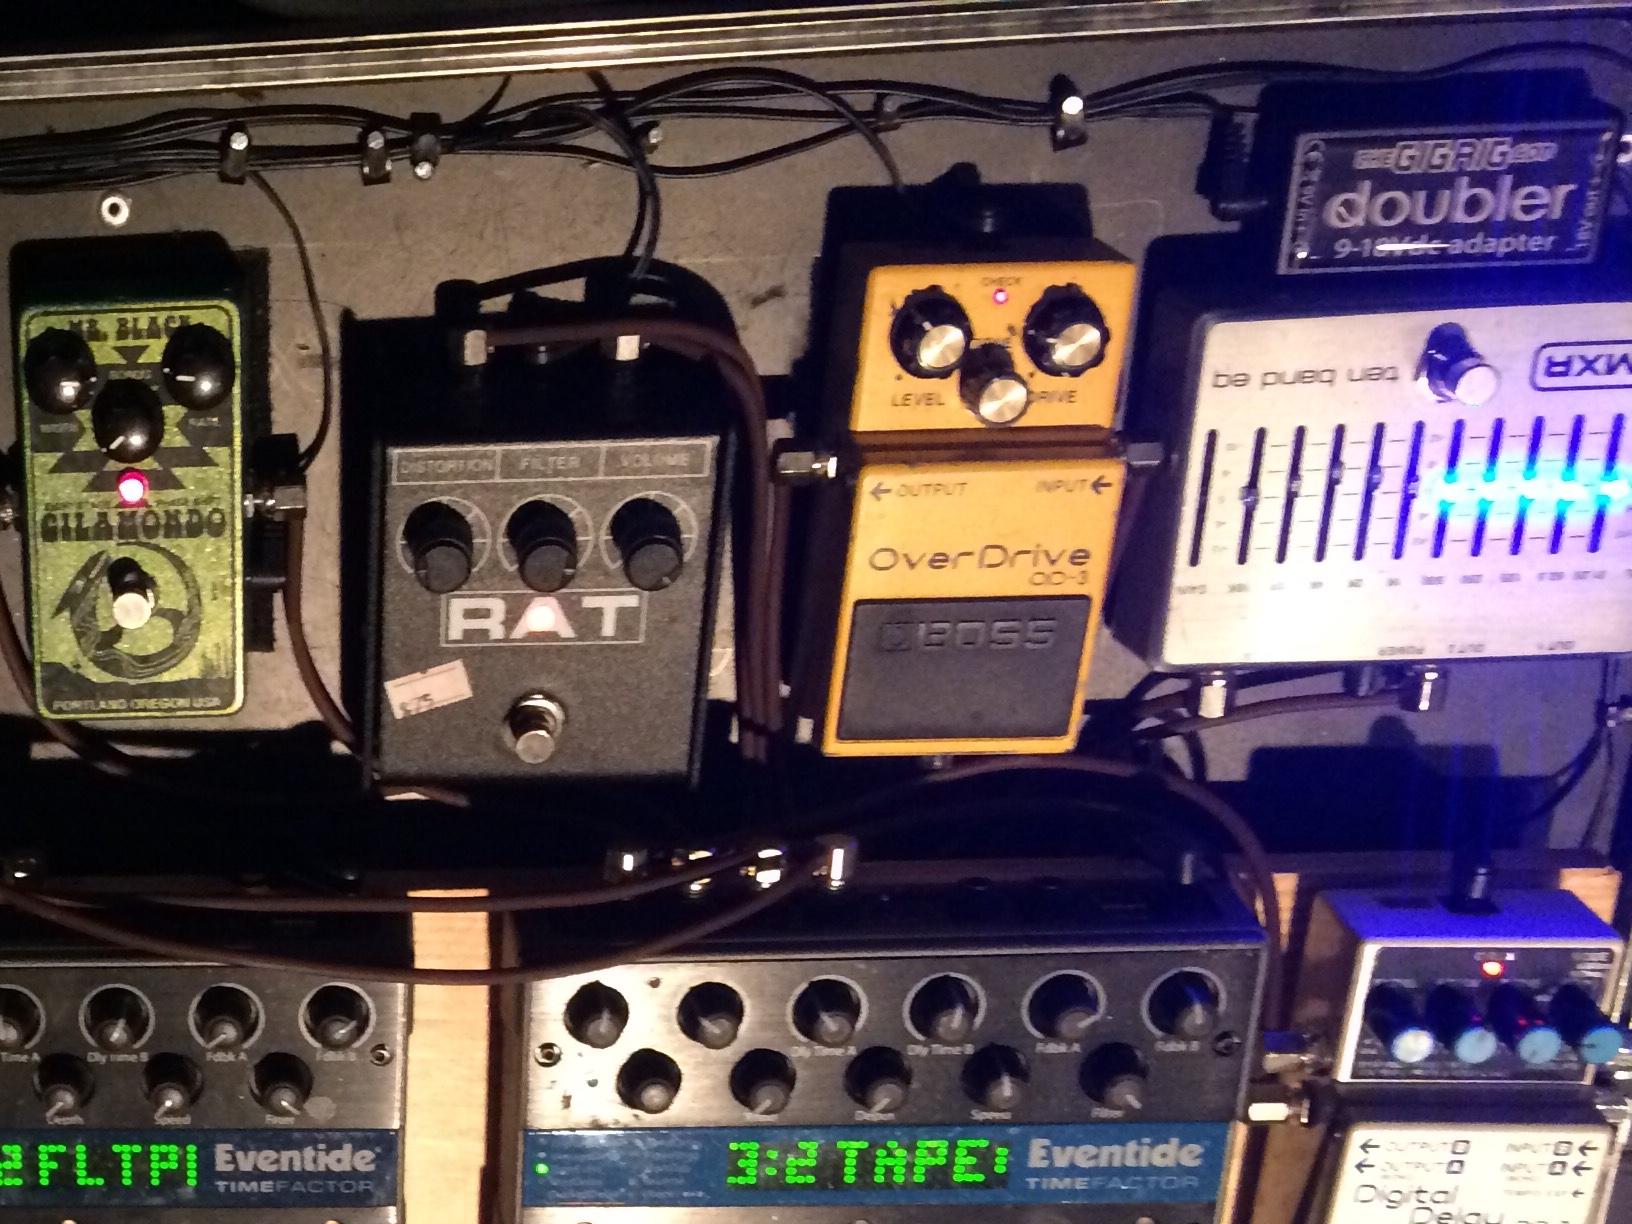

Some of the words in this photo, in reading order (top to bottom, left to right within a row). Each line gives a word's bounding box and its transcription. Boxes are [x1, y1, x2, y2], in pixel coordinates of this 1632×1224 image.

[1323, 173, 1579, 229] doubler
[1448, 232, 1558, 259] adapter
[1347, 365, 1400, 383] ten
[1544, 352, 1632, 379] MXR
[1212, 369, 1252, 389] eq
[1260, 368, 1338, 390] band
[891, 392, 945, 408] LEVEL
[517, 455, 581, 472] FILTER
[895, 480, 968, 498] OUTPUT
[1035, 478, 1089, 494] INPUT
[447, 594, 640, 640] RAT
[918, 618, 1058, 651] BOSS
[214, 1143, 377, 1173] Eventide
[1027, 1137, 1205, 1169] Eventide
[215, 1180, 376, 1193] TIMEFACTOR
[1352, 1183, 1460, 1210] Digital
